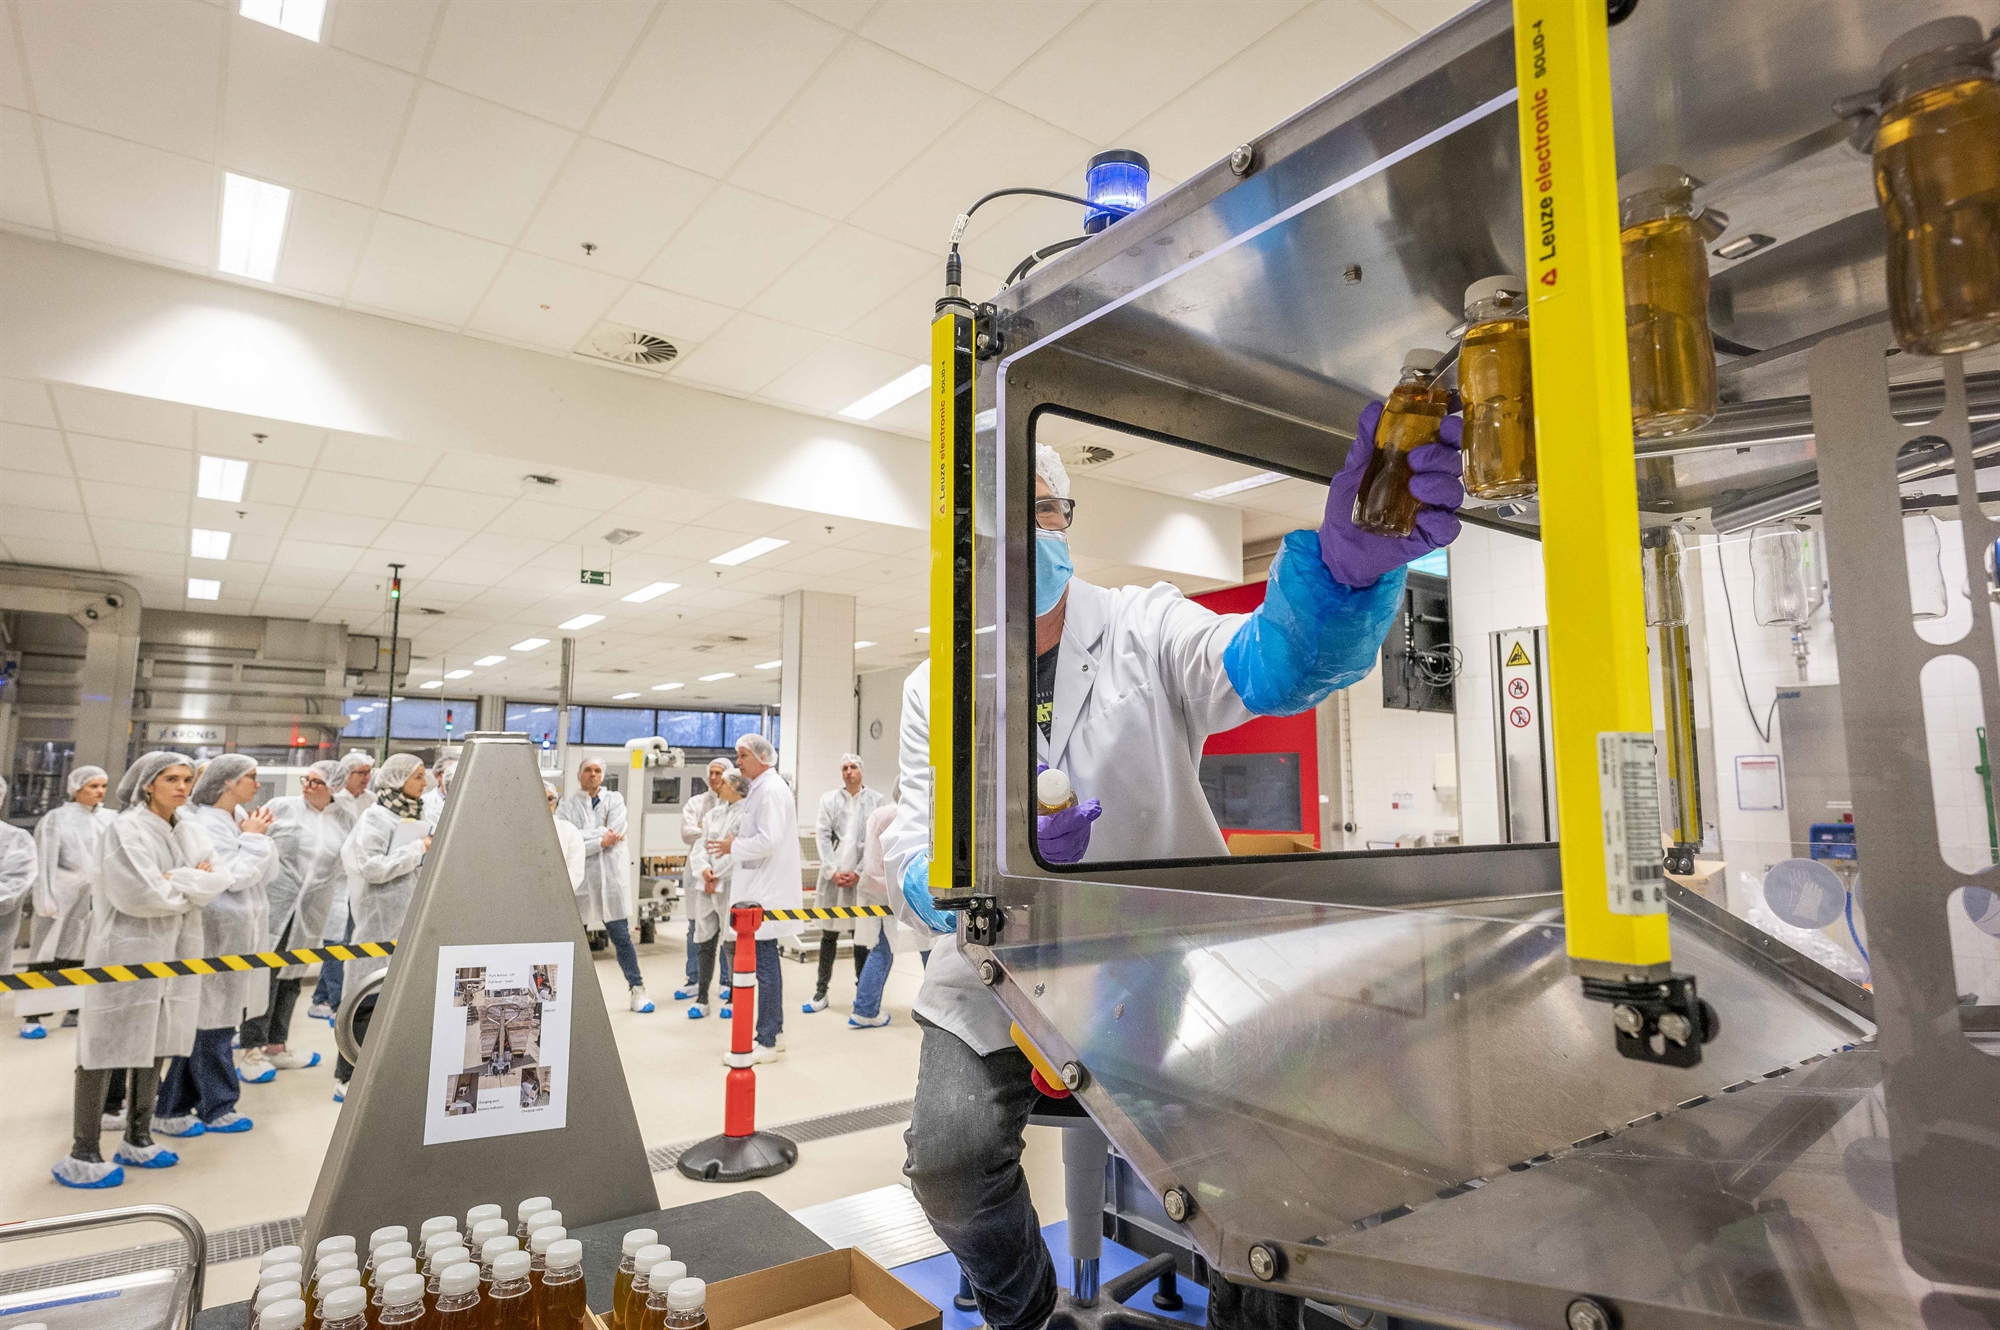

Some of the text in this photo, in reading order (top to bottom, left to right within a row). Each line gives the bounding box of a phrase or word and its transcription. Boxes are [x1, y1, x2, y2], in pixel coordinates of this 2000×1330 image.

[1531, 19, 1556, 262] Leuze electronic SOLID-4
